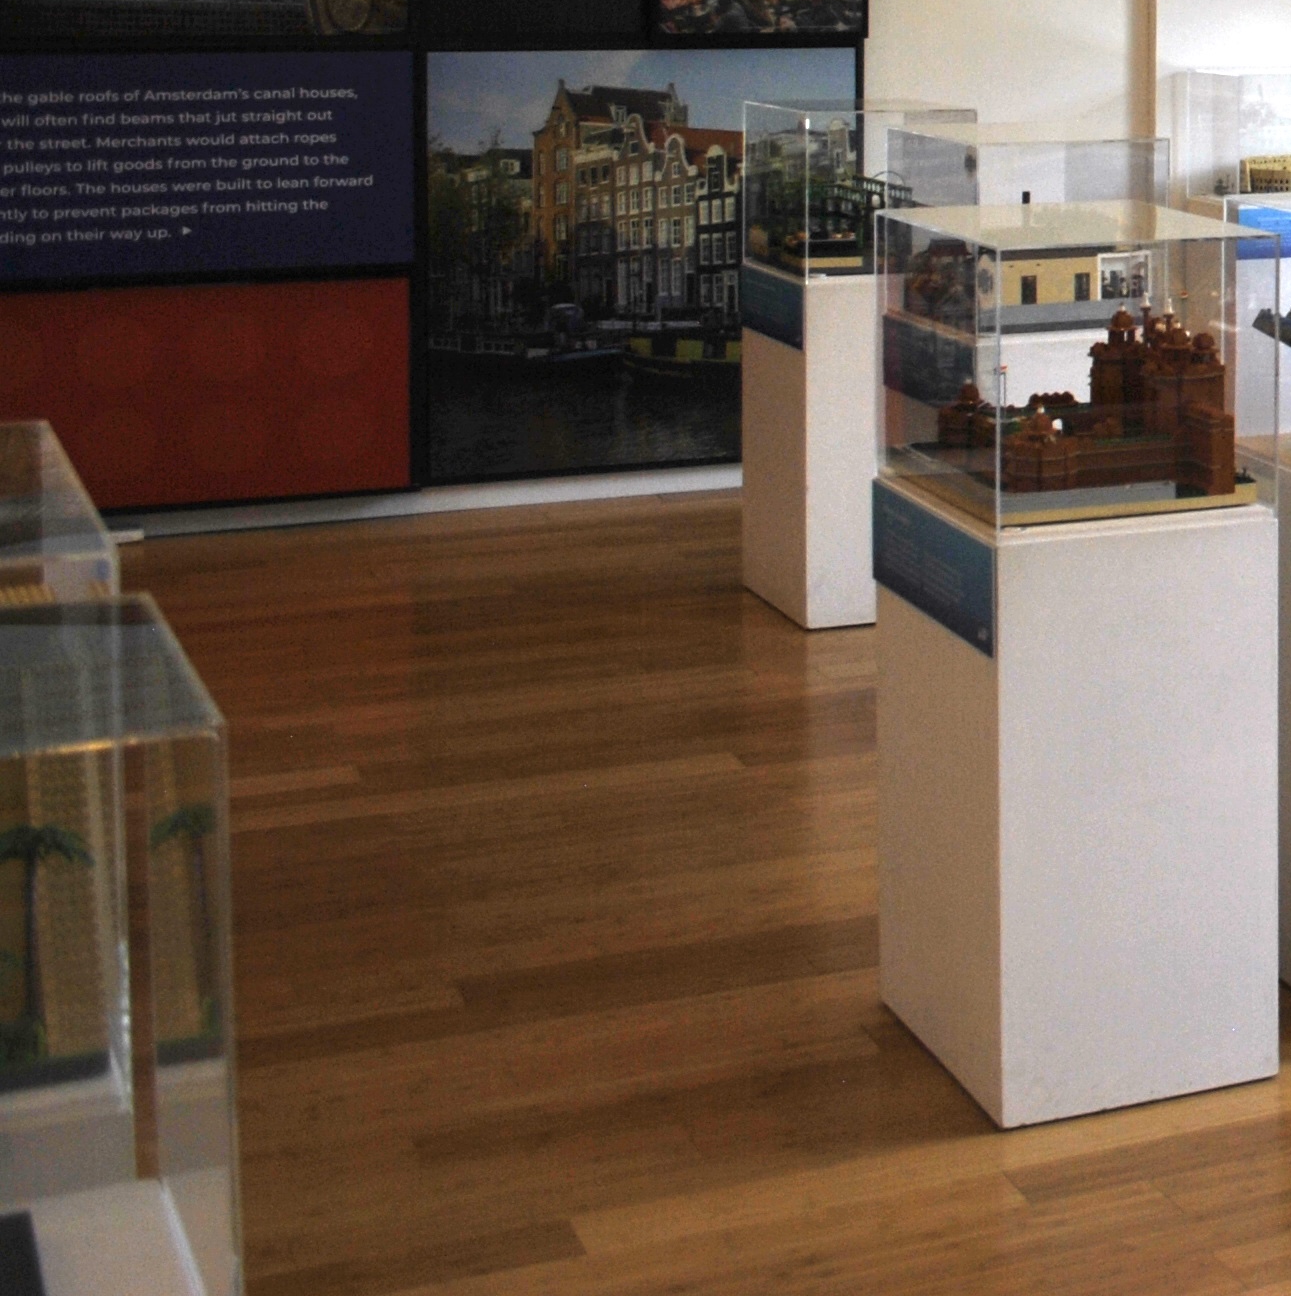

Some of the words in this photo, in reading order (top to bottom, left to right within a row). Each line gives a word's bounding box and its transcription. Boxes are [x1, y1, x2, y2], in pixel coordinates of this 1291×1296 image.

[1, 91, 23, 103] he
[28, 90, 74, 106] gable
[79, 89, 119, 102] roofs
[124, 89, 140, 101] of
[254, 86, 295, 99] canal
[300, 86, 358, 99] houses,
[1, 113, 29, 126] will
[35, 112, 77, 125] often
[82, 111, 115, 124] find
[120, 111, 175, 123] beams
[179, 110, 211, 123] that
[214, 110, 237, 125] jut
[242, 109, 303, 124] straight
[307, 108, 333, 121] out
[7, 137, 35, 149] the
[39, 136, 91, 149] street.
[96, 134, 182, 147] Merchants
[185, 132, 235, 146] would
[239, 131, 290, 144] attach
[294, 133, 337, 146] ropes
[4, 160, 62, 176] pulleys
[66, 159, 83, 171] to
[86, 158, 108, 171] lift
[113, 157, 163, 173] goods
[167, 156, 207, 169] from
[211, 155, 238, 168] the
[242, 153, 299, 170] ground
[303, 153, 320, 165] to
[323, 152, 349, 165] the
[21, 183, 71, 195] floors.
[75, 181, 106, 194] The
[111, 181, 168, 193] houses
[171, 181, 212, 191] were
[216, 177, 252, 190] built
[256, 177, 272, 189] to
[277, 176, 309, 188] lean
[313, 174, 373, 187] forward
[33, 206, 49, 218] to
[53, 203, 117, 220] prevent
[122, 202, 198, 218] packages
[202, 200, 241, 213] from
[246, 198, 298, 213] hitting
[302, 197, 328, 210] the
[41, 231, 62, 241] on
[67, 227, 105, 240] their
[109, 229, 142, 241] way
[147, 228, 171, 241] up.
